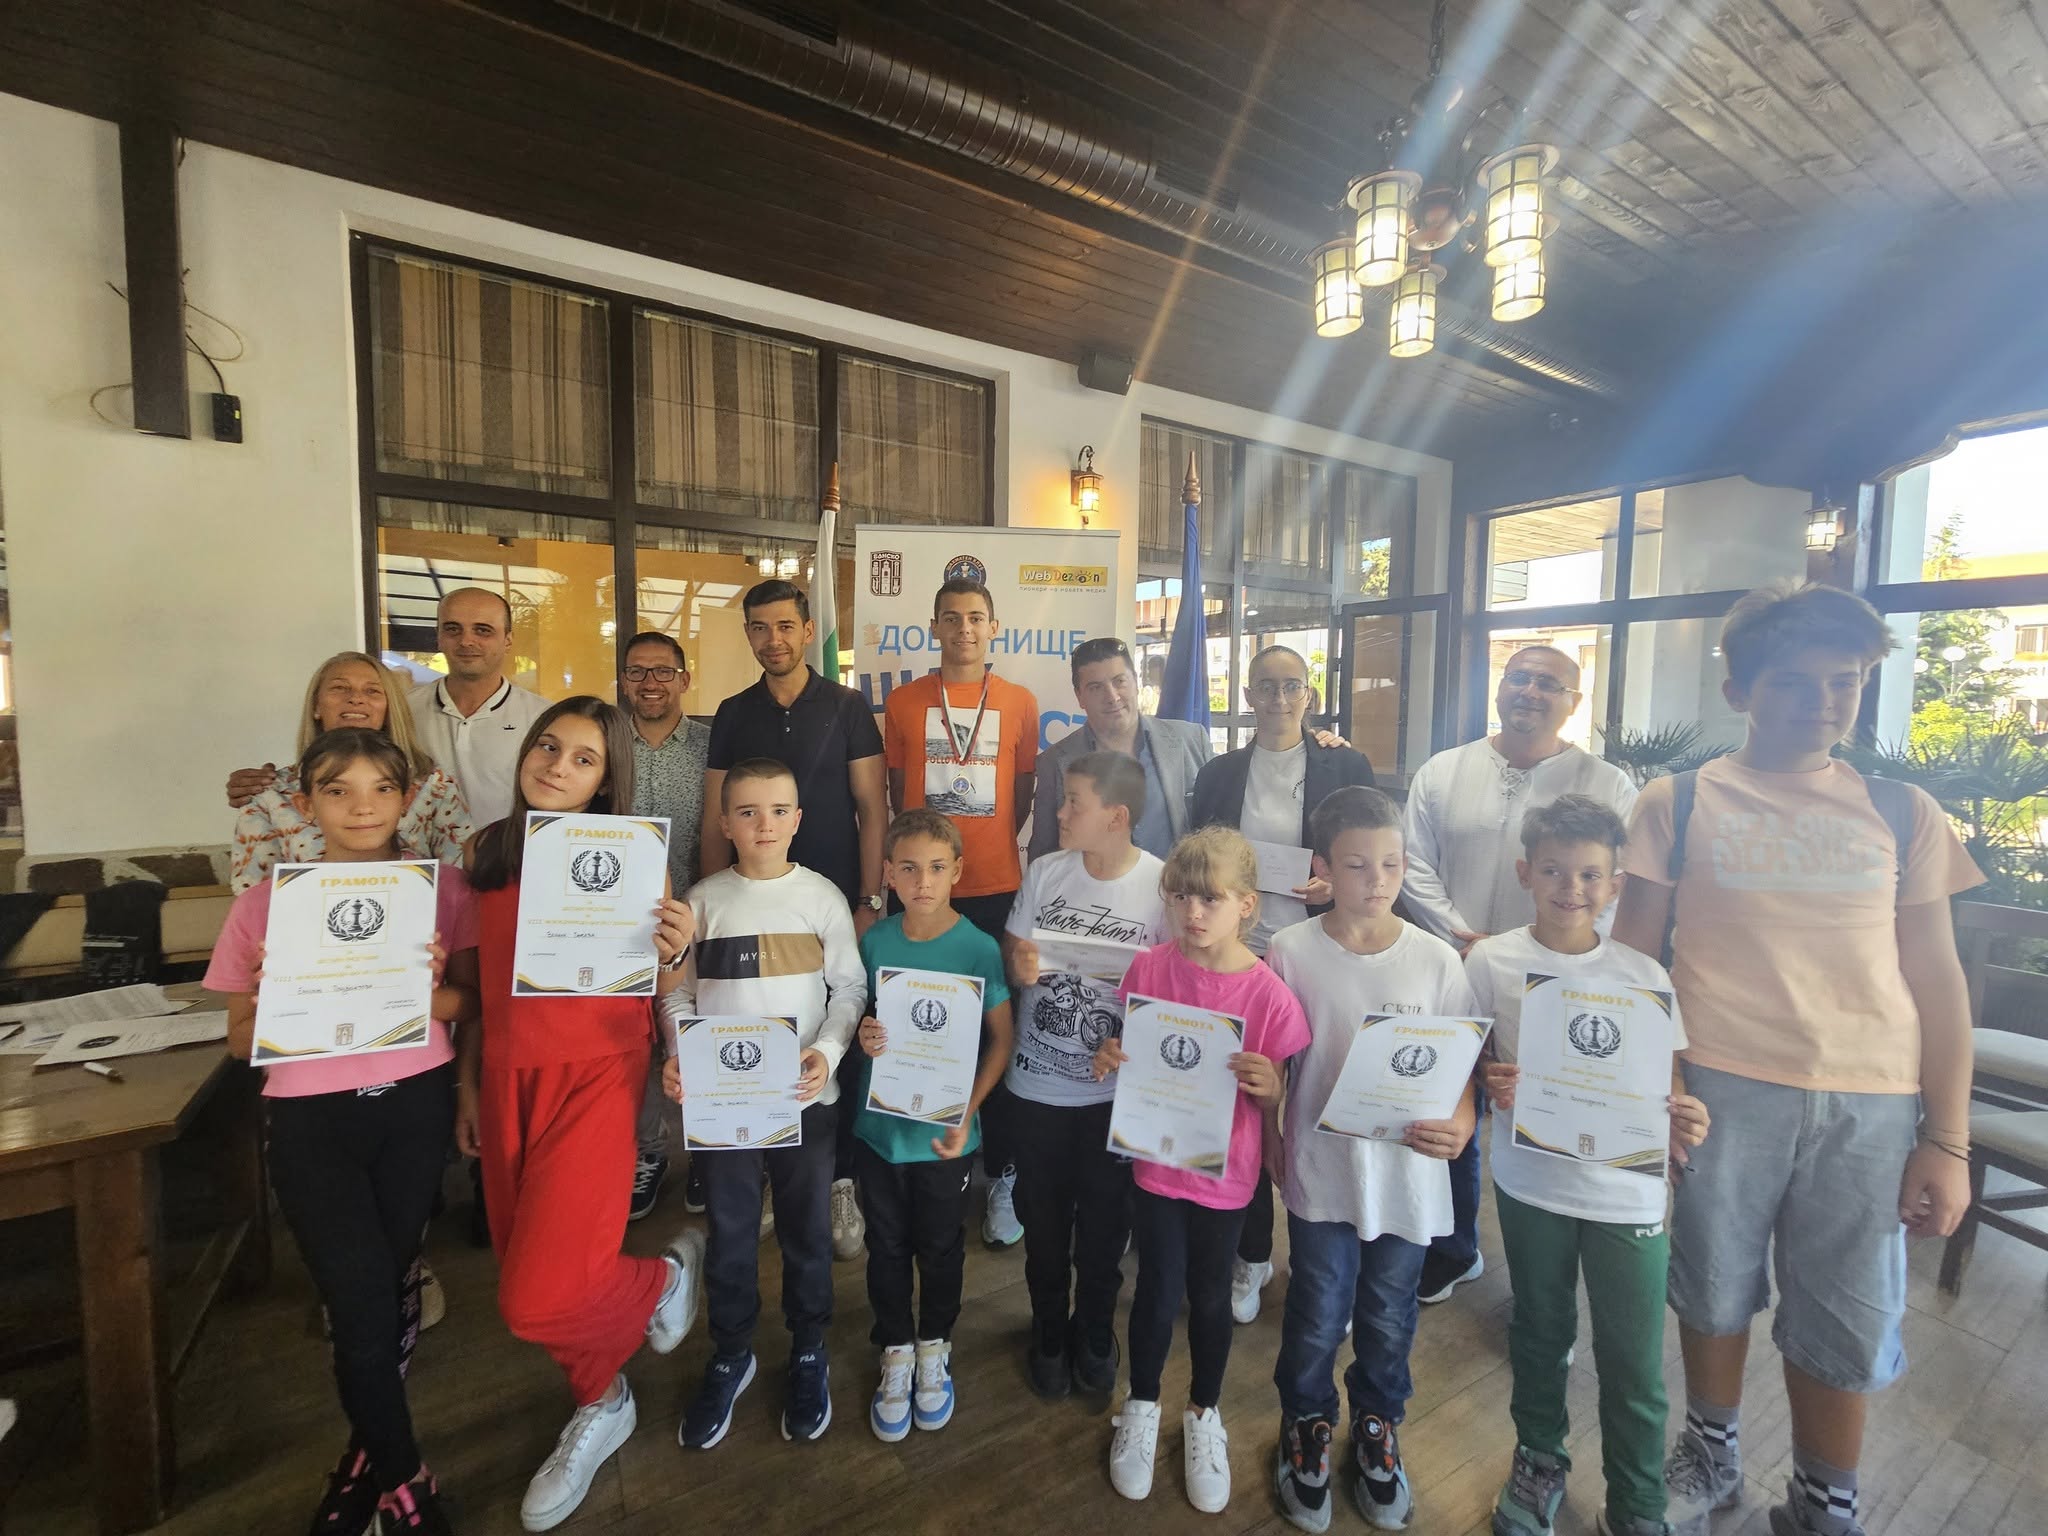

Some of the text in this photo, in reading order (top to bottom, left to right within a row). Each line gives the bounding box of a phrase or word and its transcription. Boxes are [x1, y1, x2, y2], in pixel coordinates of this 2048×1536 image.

[565, 827, 635, 841] ГРАМОТА
[319, 875, 400, 888] ГРАМОТА
[906, 979, 959, 994] ГРАМОТА
[1561, 988, 1635, 1009] ГРАМОТА
[1156, 1012, 1215, 1032] ГРАМОТА
[710, 1024, 771, 1035] ГРАМОТА
